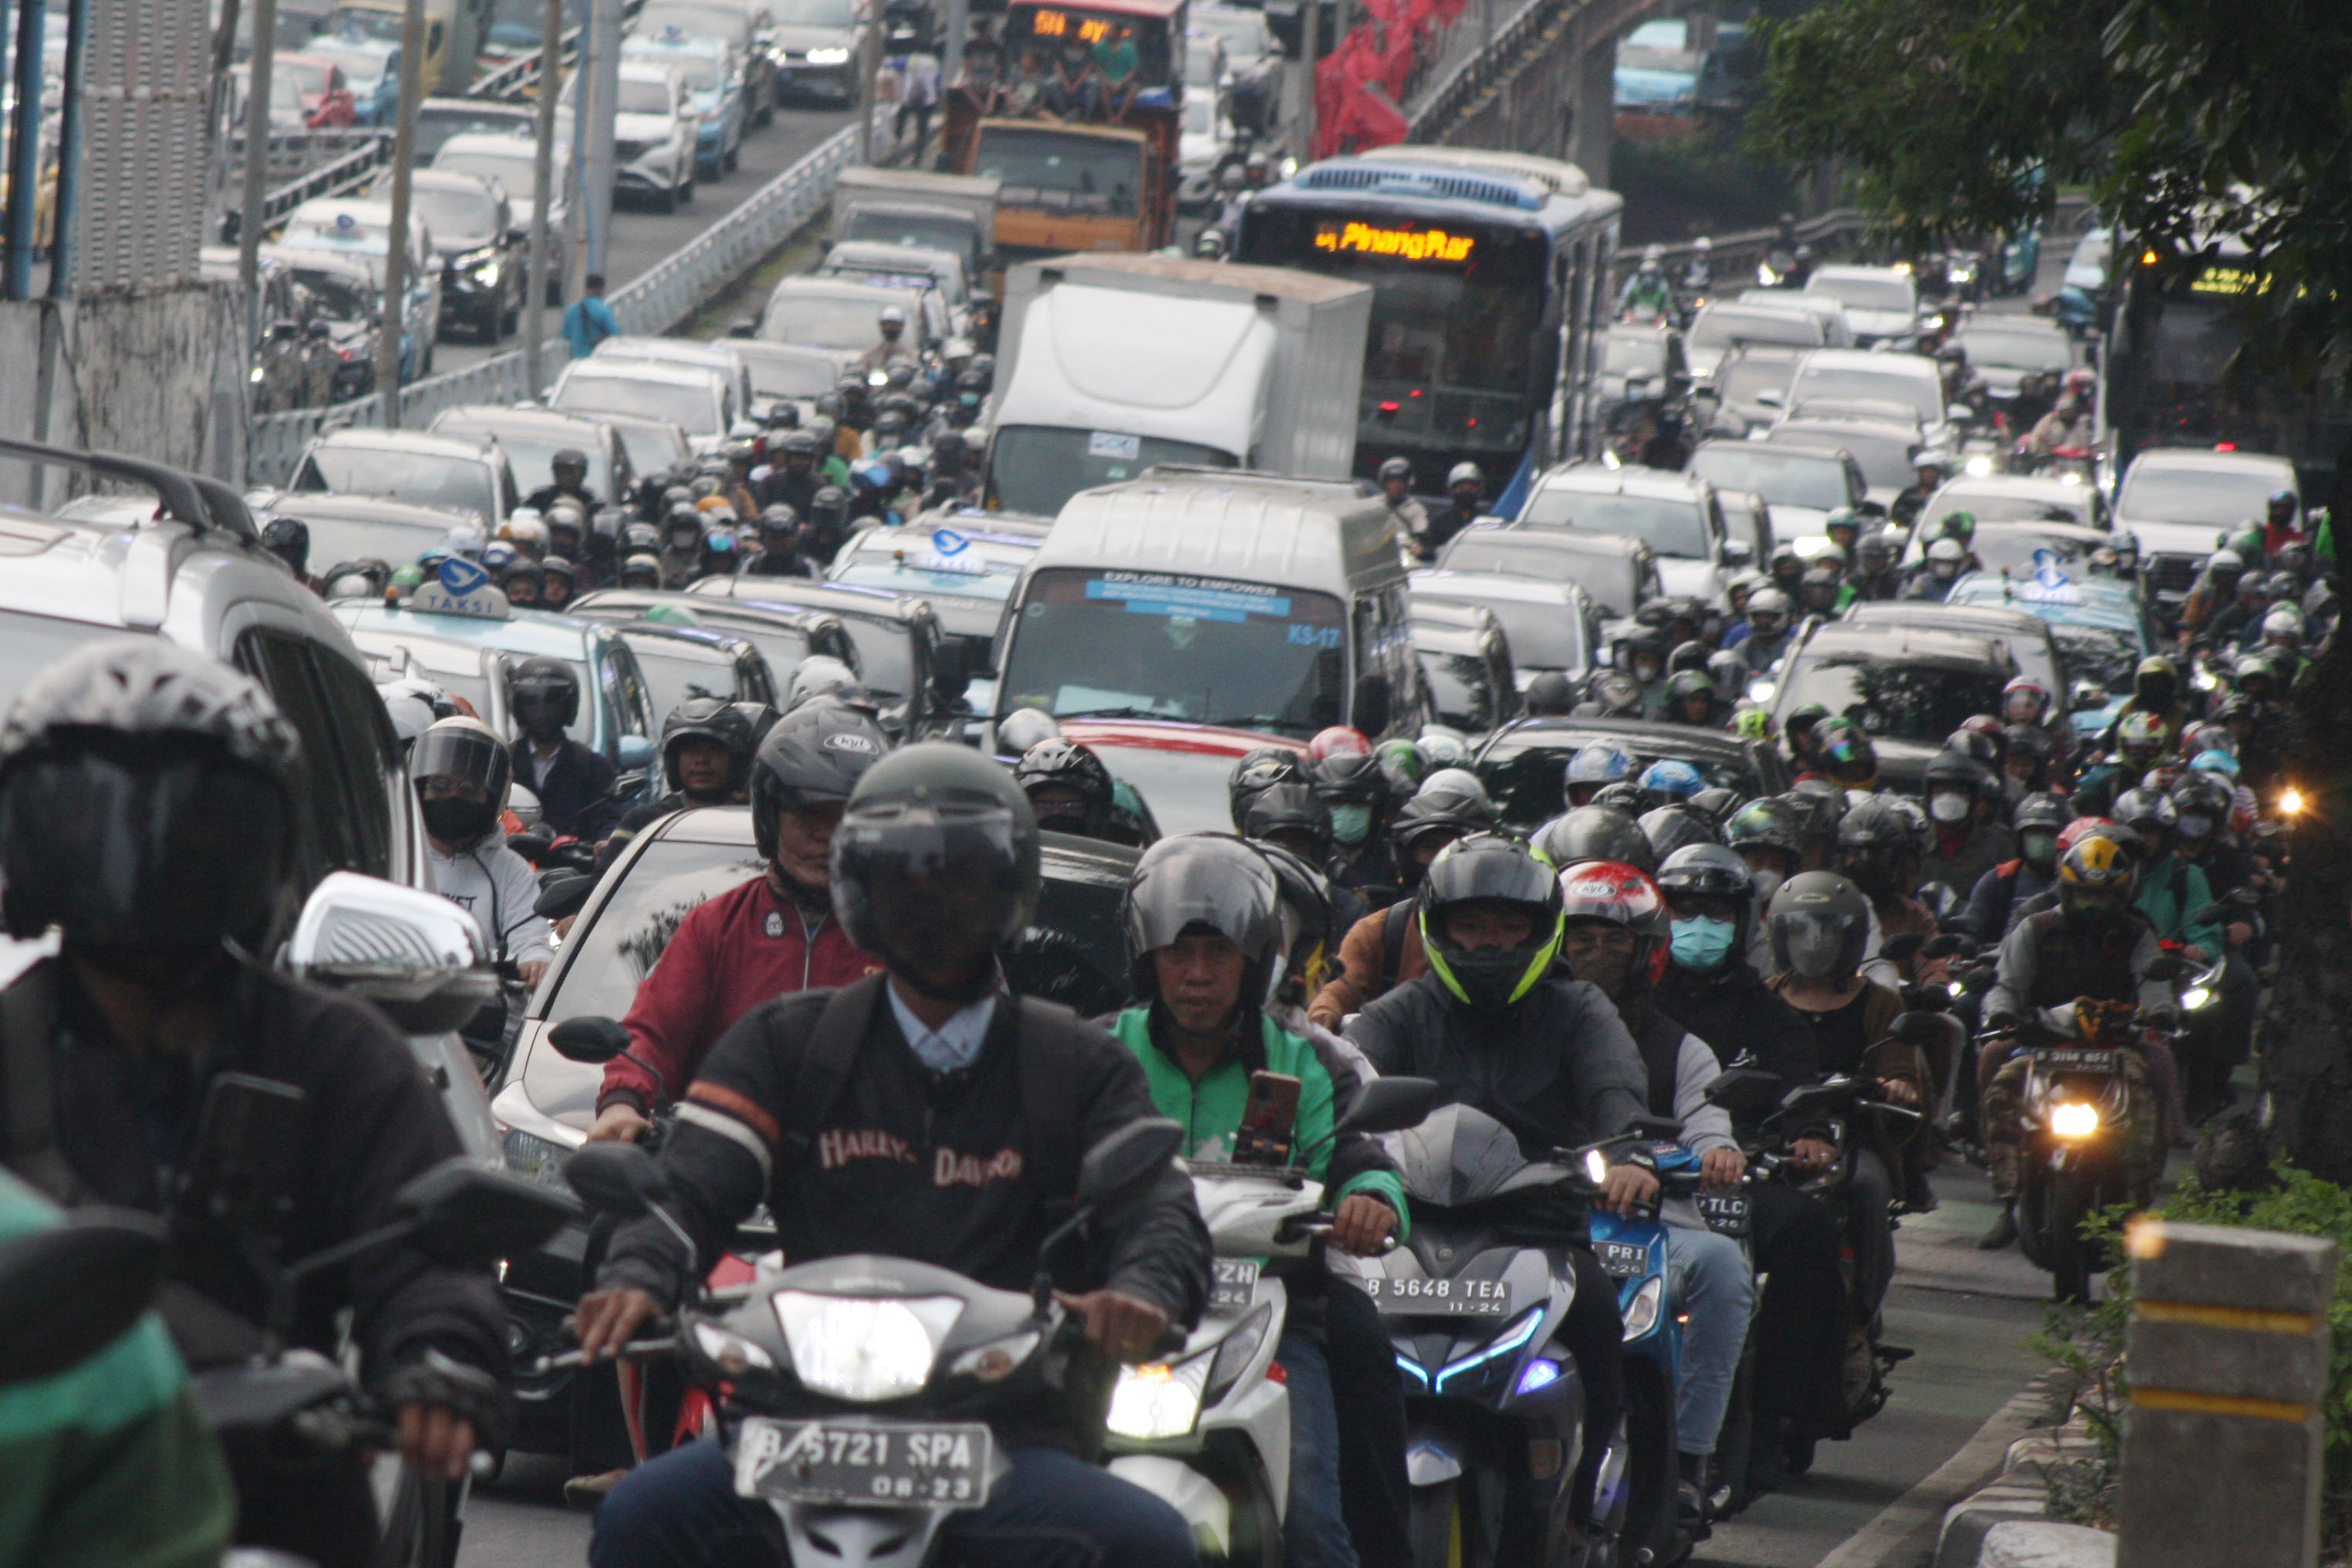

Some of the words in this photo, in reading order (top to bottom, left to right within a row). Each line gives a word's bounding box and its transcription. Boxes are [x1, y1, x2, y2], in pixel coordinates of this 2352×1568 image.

[1176, 577, 1198, 587] TO
[428, 595, 493, 613] TAKSI
[1708, 1198, 1744, 1215] TLC
[1607, 1244, 1644, 1261] PRI
[1368, 1278, 1381, 1297] B
[1394, 1279, 1450, 1297] 5648
[1466, 1280, 1506, 1300] TEA
[906, 1432, 971, 1469] SPA
